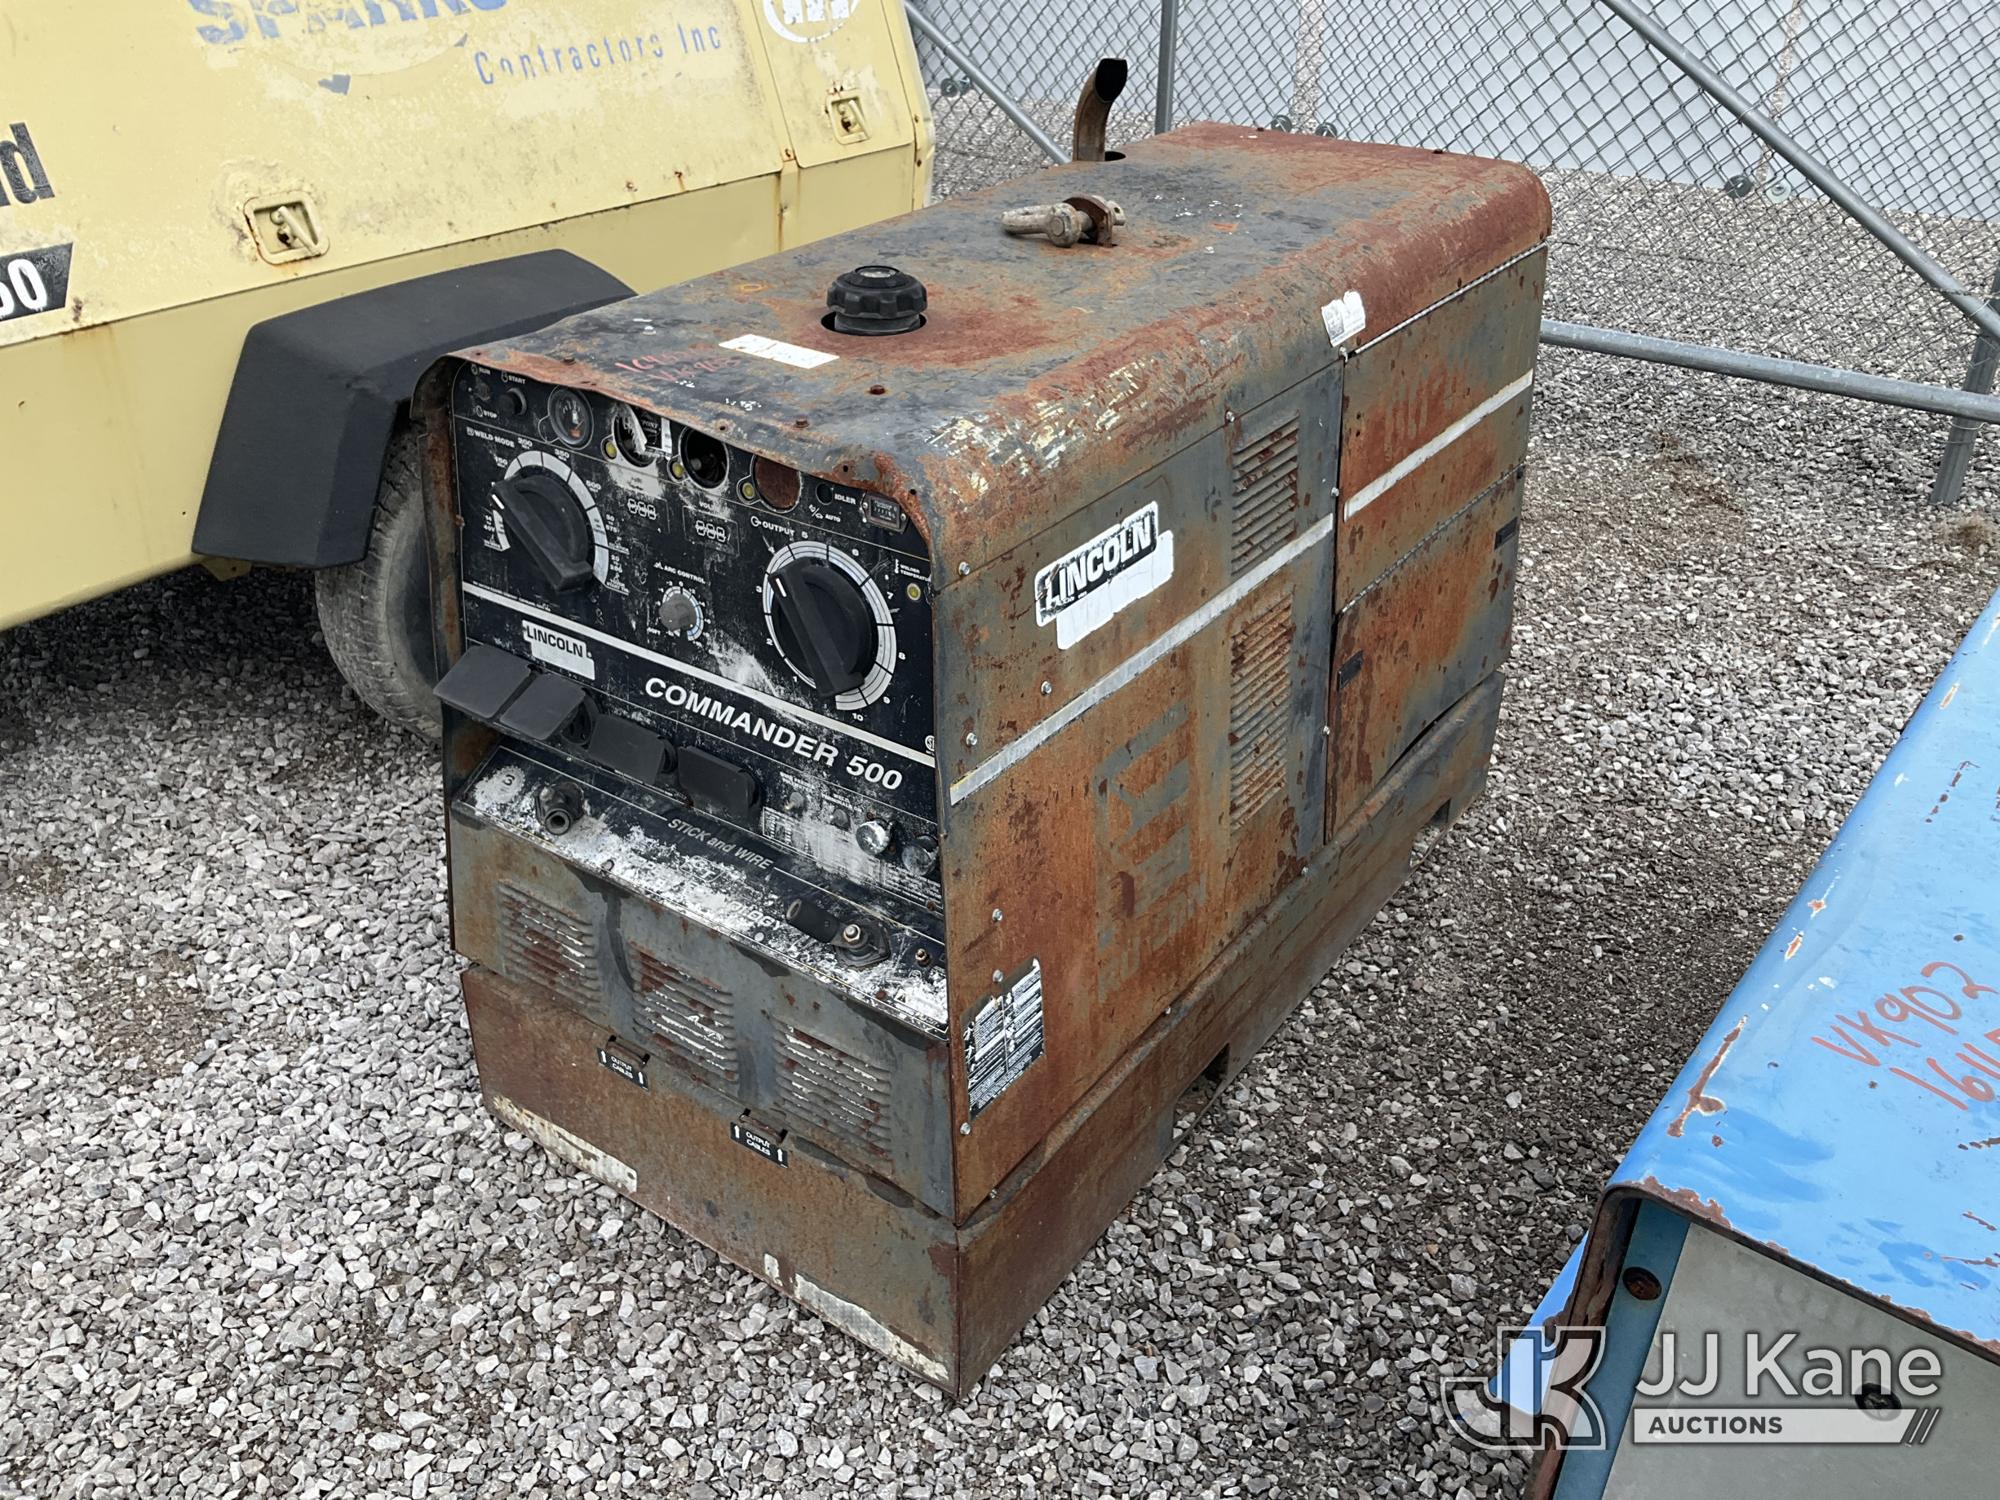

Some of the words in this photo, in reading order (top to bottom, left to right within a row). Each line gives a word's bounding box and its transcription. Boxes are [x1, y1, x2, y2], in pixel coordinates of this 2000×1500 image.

[474, 34, 664, 85] Contractors
[677, 23, 721, 55] Inc
[0, 122, 55, 207] d
[508, 375, 526, 384] START
[483, 409, 498, 418] STOP
[474, 430, 494, 441] WELD
[494, 436, 515, 448] MODE
[834, 493, 856, 505] IDLER
[825, 513, 841, 523] AUTO
[762, 521, 795, 536] OUTPUT
[900, 564, 920, 574] WELDER
[1044, 514, 1152, 610] LINCOLN
[664, 565, 677, 574] ARC
[677, 569, 706, 584] CONTROL
[900, 569, 931, 582] TEMPERATU
[526, 625, 583, 658] LINCOLN
[852, 712, 864, 722] 10
[645, 677, 839, 767] COMMANDER
[846, 755, 903, 790] 500
[502, 774, 515, 786] 3
[667, 818, 711, 843] STICK
[707, 836, 736, 854] and
[734, 847, 776, 870] WIRE
[611, 1055, 633, 1072] OUTPUT
[611, 1063, 634, 1079] CABLES
[745, 1131, 770, 1148] OUTPUT
[746, 1139, 771, 1156] CABLES
